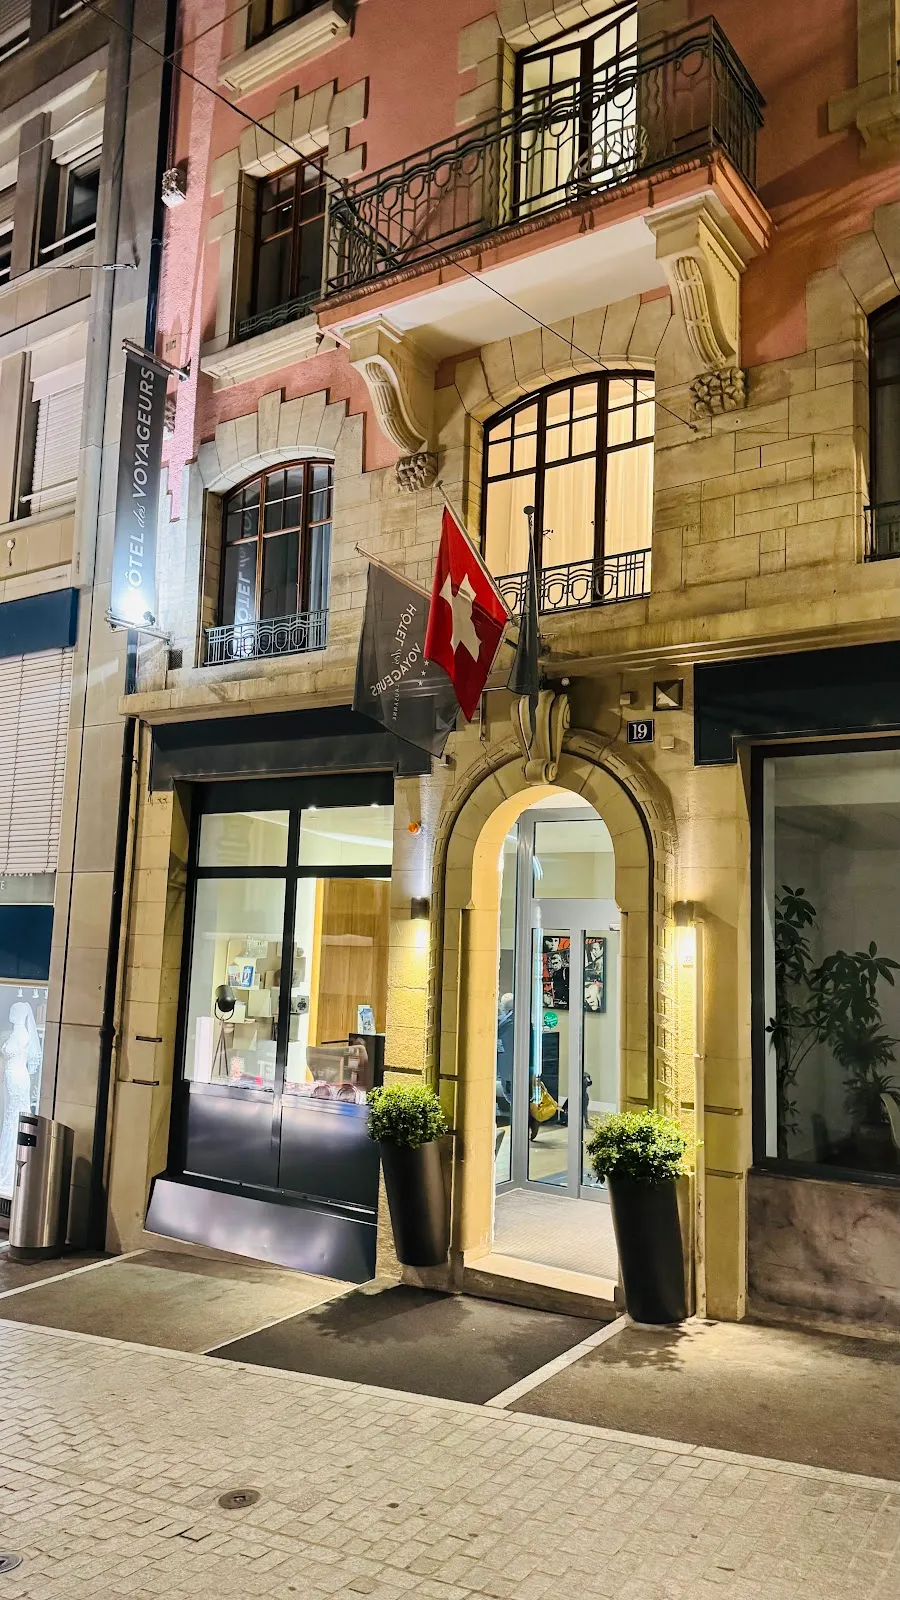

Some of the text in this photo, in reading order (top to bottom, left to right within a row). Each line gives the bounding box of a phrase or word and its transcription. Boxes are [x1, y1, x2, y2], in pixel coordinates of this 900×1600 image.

[125, 367, 154, 592] ÔTEL des VOYAGEURS
[632, 723, 648, 740] 19
